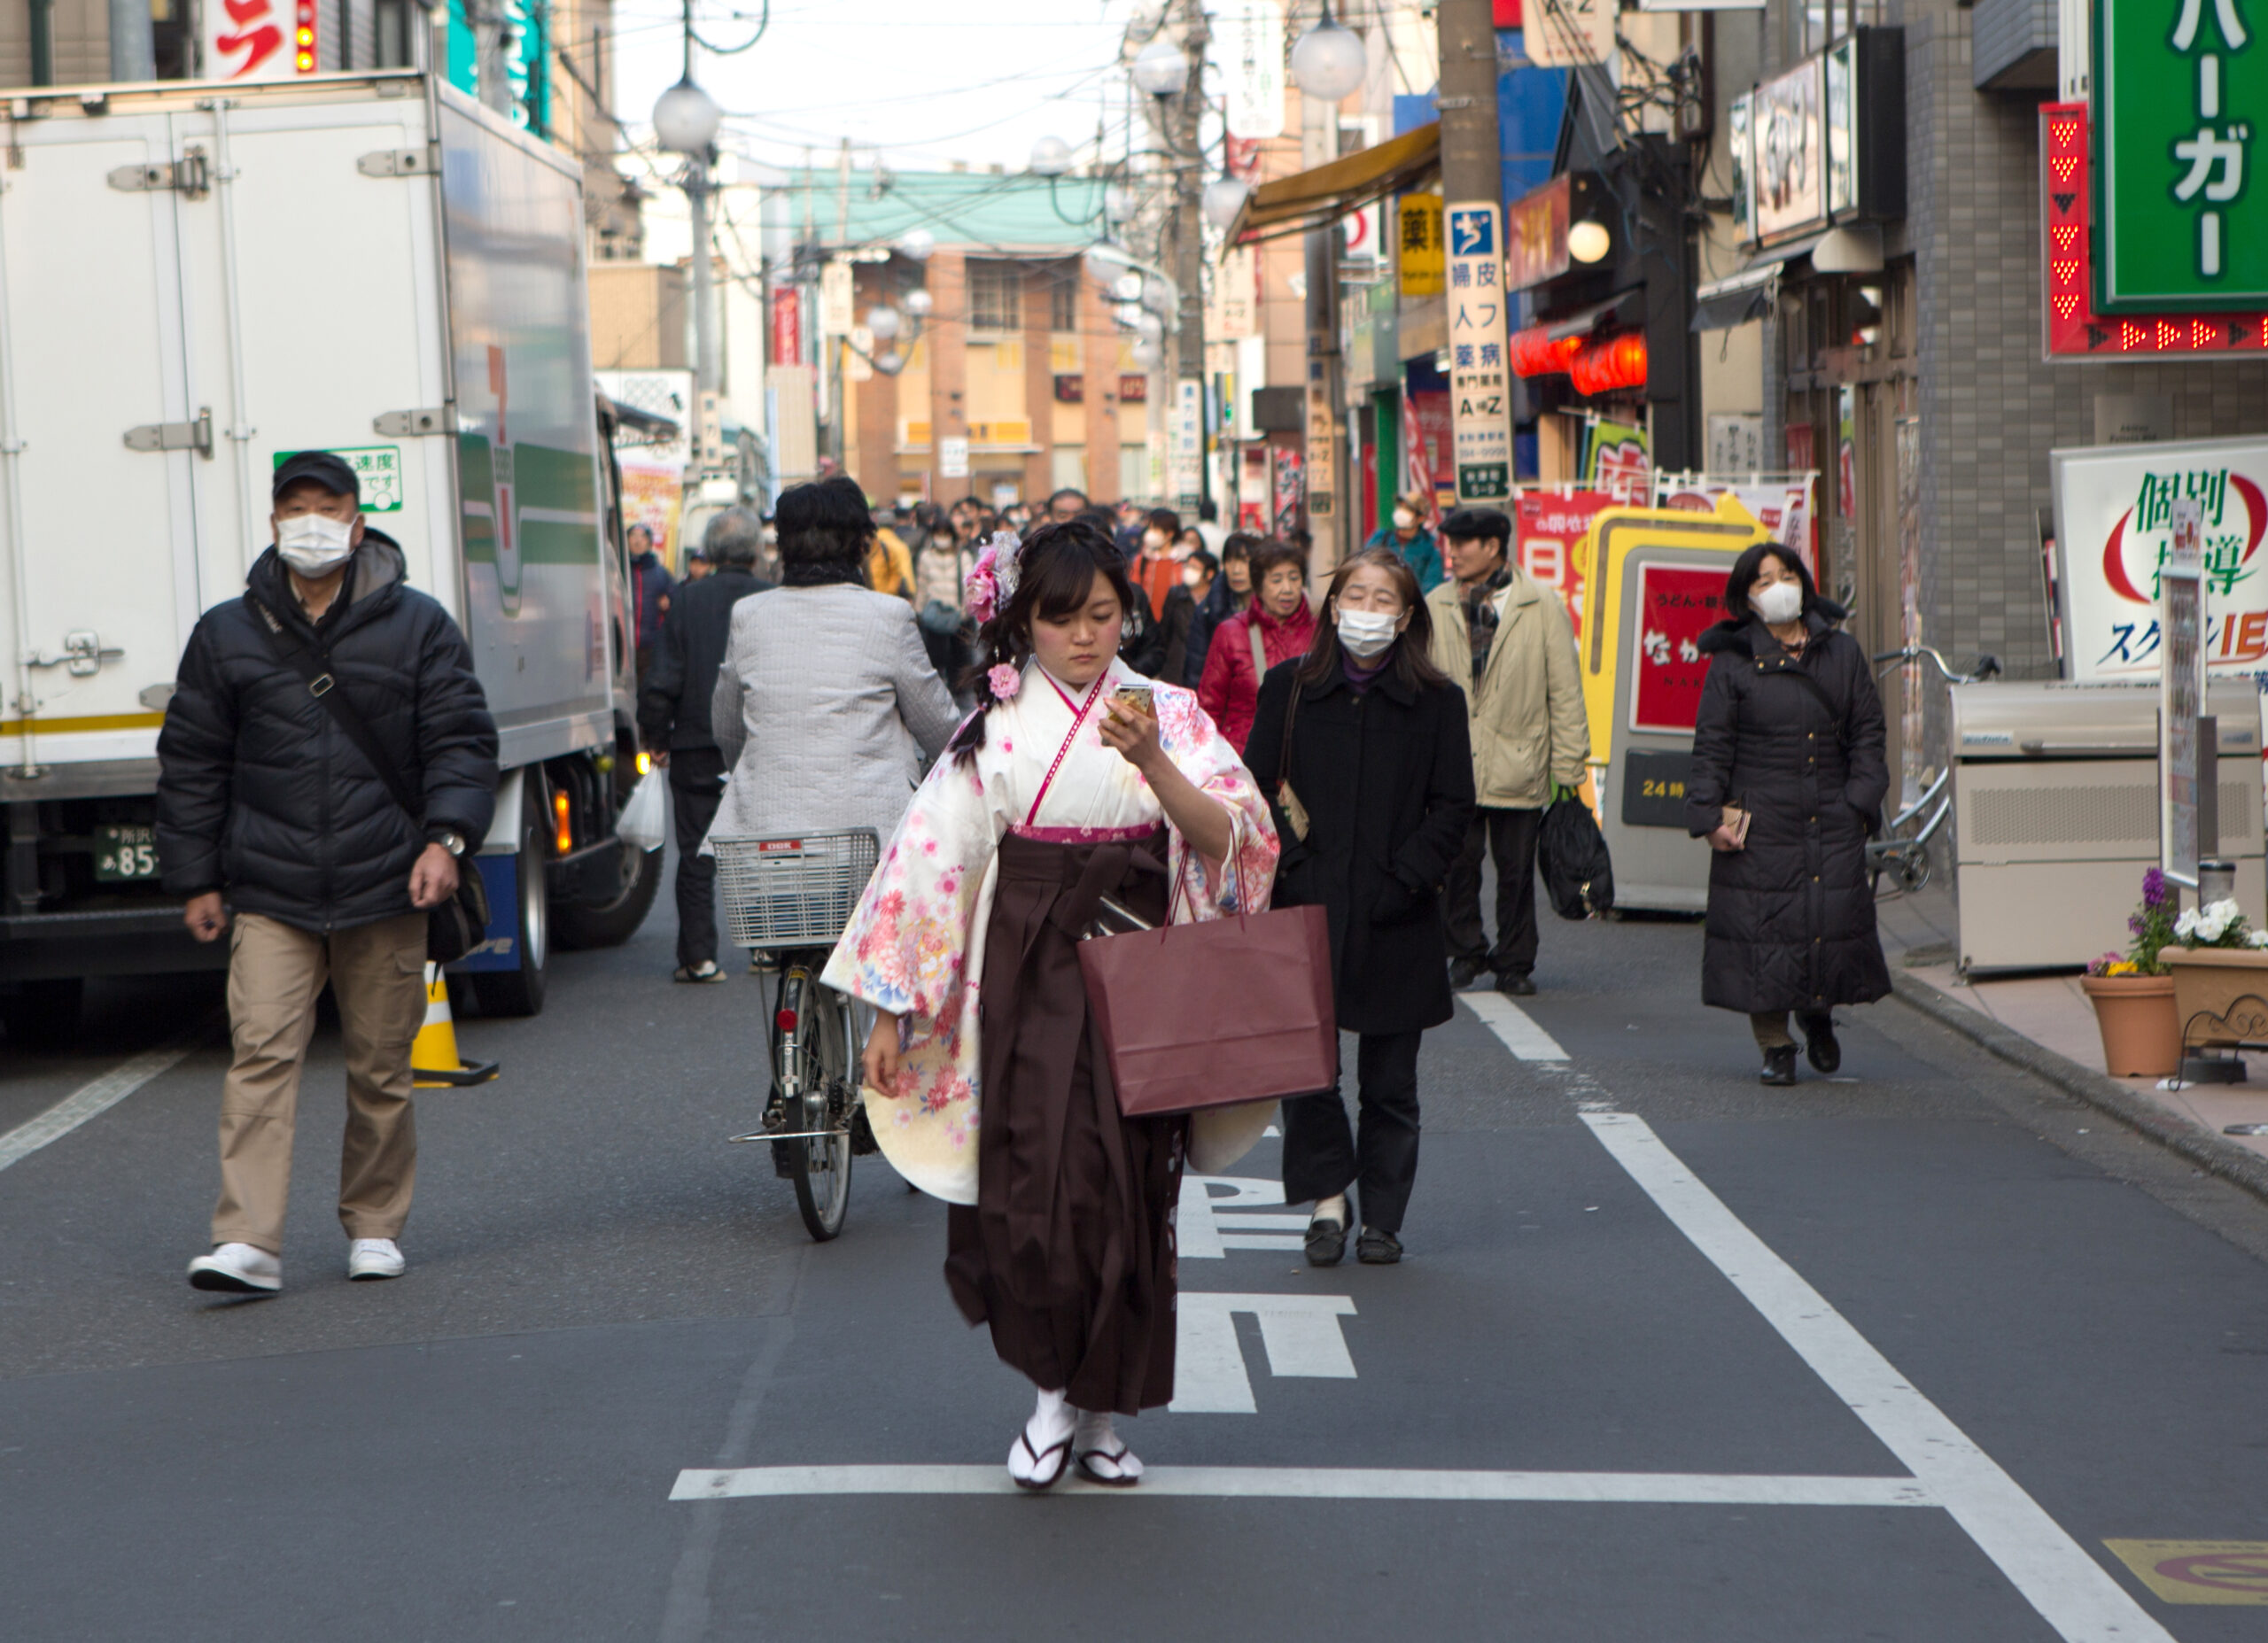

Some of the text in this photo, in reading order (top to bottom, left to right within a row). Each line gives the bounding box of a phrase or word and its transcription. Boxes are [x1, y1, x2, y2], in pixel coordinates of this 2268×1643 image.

[1452, 263, 1474, 369] 婦人薬
[1476, 262, 1502, 368] 皮フ病
[345, 453, 396, 473] 速度
[2137, 468, 2227, 533] 個別
[1643, 627, 1712, 666] なか
